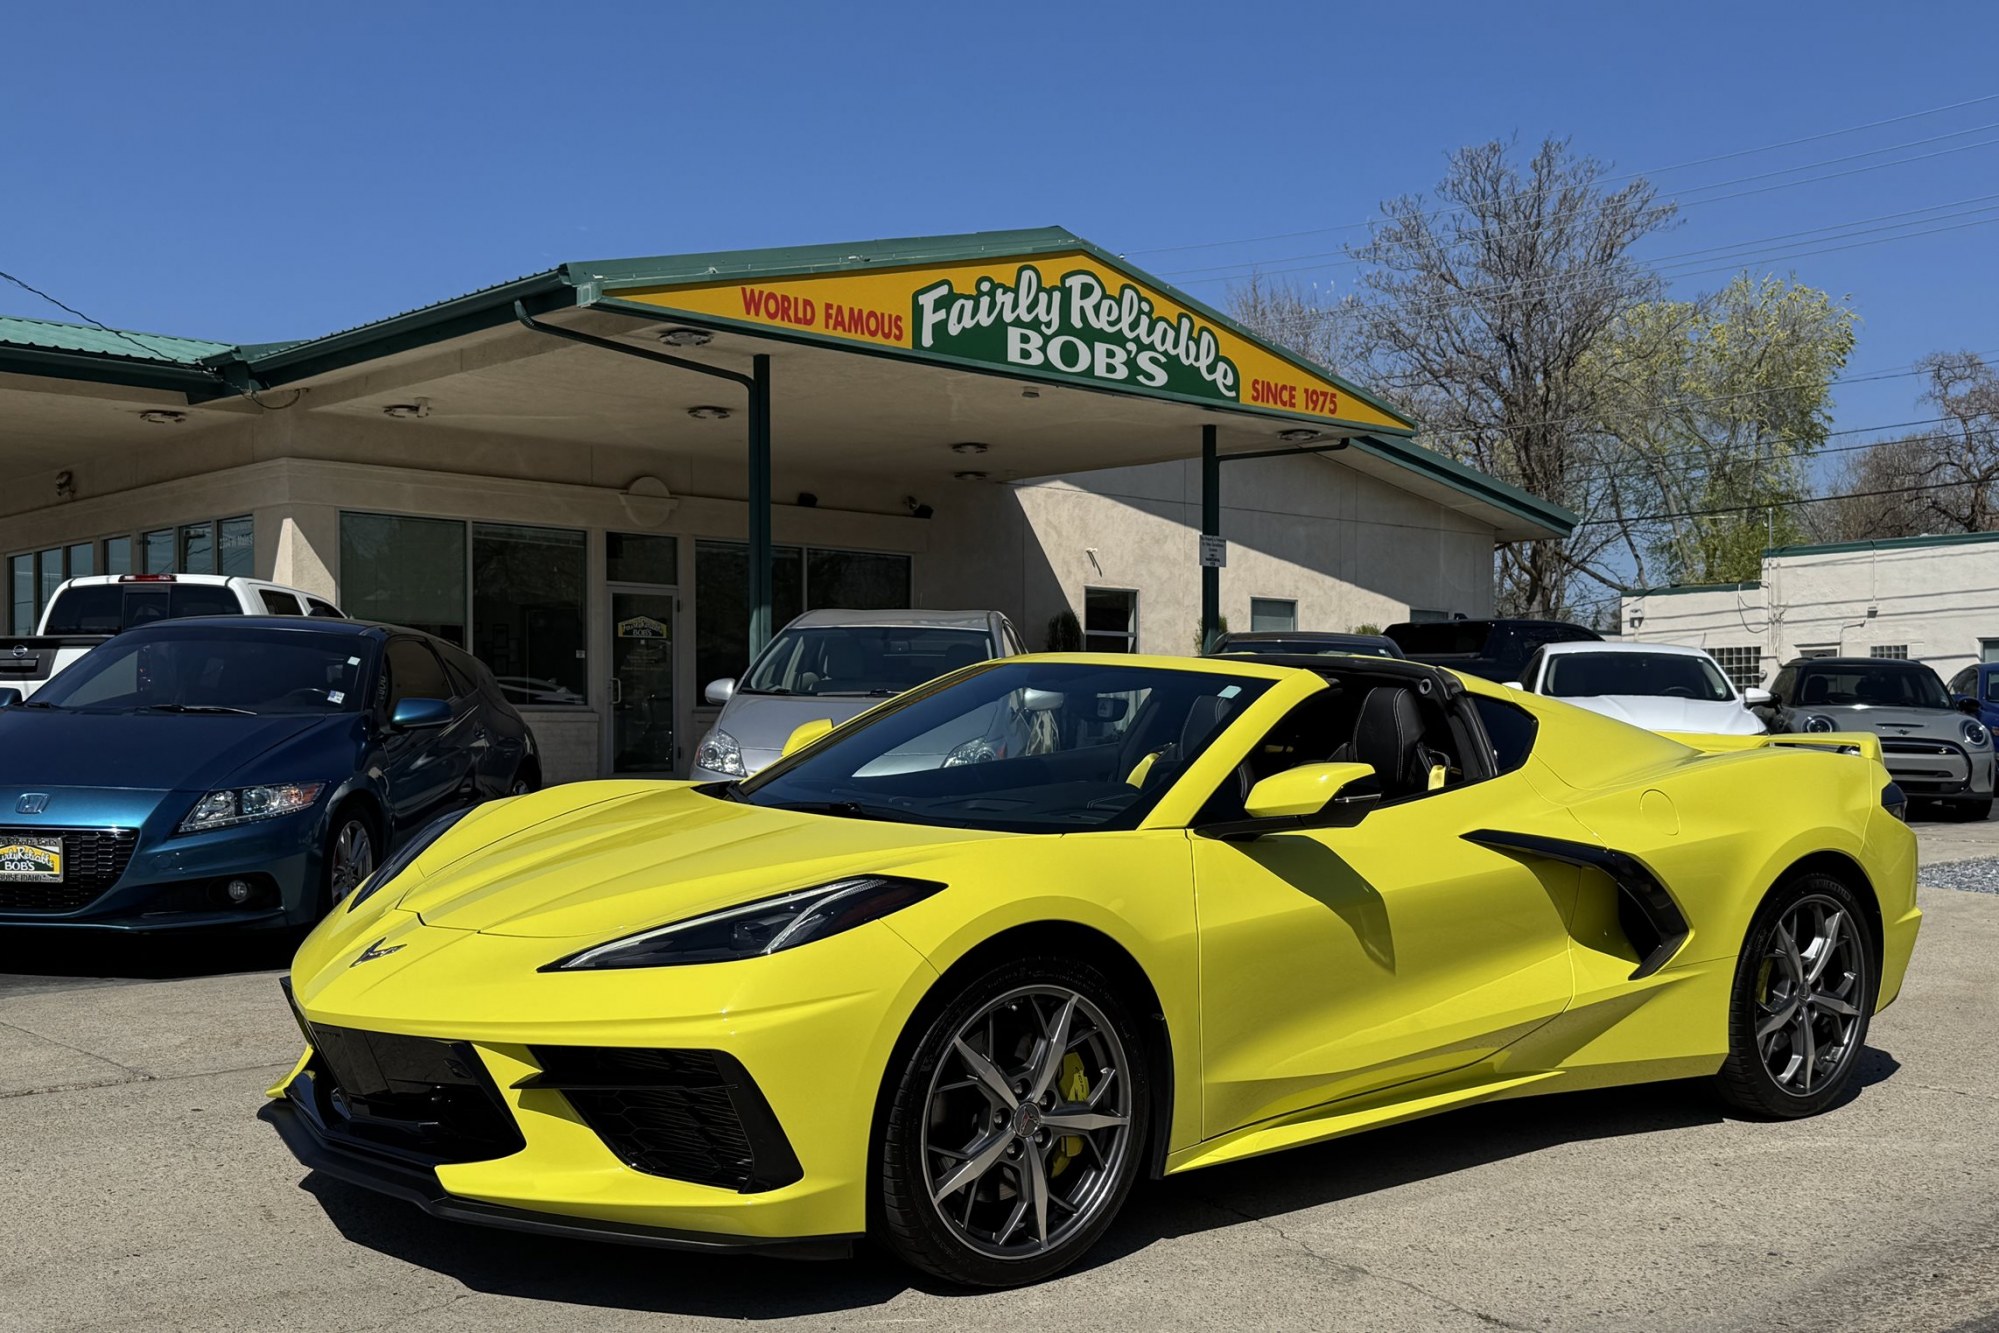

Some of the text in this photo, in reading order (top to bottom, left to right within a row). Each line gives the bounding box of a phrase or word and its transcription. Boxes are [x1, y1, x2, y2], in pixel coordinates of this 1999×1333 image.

[741, 287, 904, 341] WORLD FAMOUS
[918, 269, 1236, 397] Fairly Reliable
[1007, 326, 1168, 387] BOB'S
[1251, 378, 1337, 415] SINCE 1975
[4, 860, 35, 871] BOB'S
